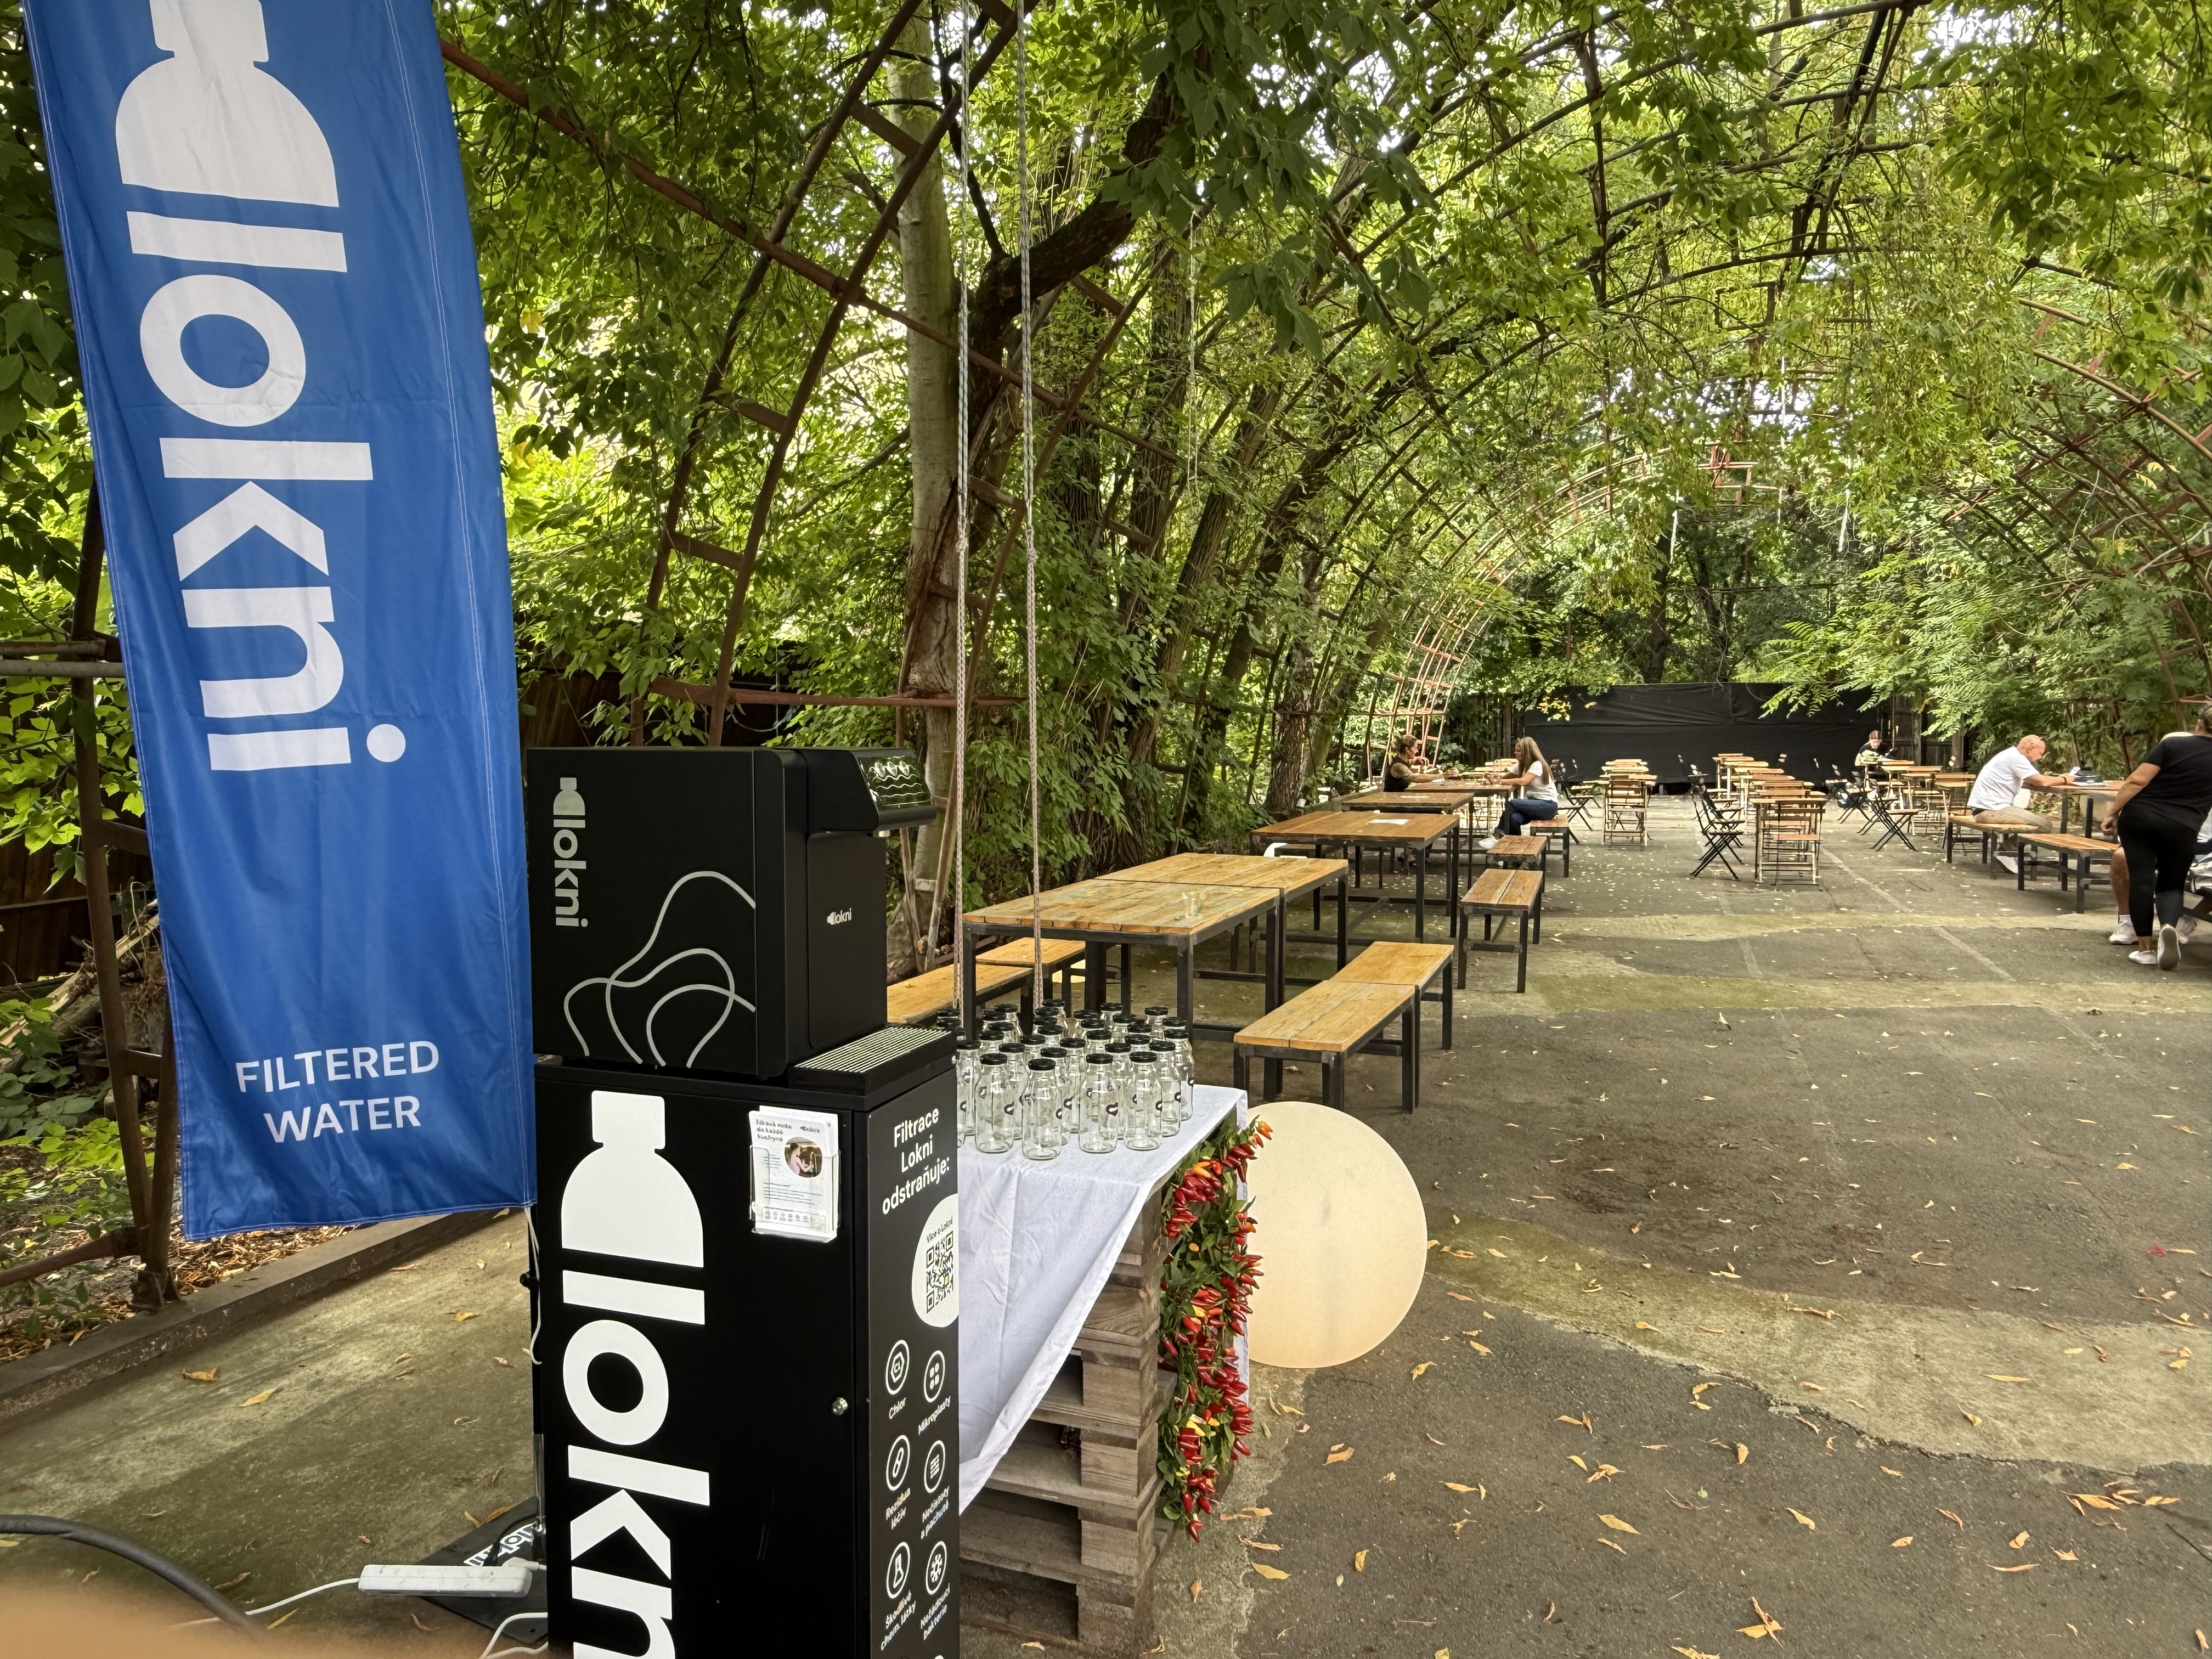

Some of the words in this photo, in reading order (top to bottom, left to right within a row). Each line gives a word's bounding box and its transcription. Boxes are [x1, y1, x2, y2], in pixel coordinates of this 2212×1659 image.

[127, 211, 407, 770] lokni
[554, 819, 588, 928] lokni
[834, 907, 852, 924] lokni
[235, 1040, 439, 1093] FILTERED
[263, 1096, 422, 1143] WATER
[894, 1108, 939, 1148] Filtrace
[901, 1133, 933, 1173] Lokni
[882, 1156, 950, 1215] odstraňuje:
